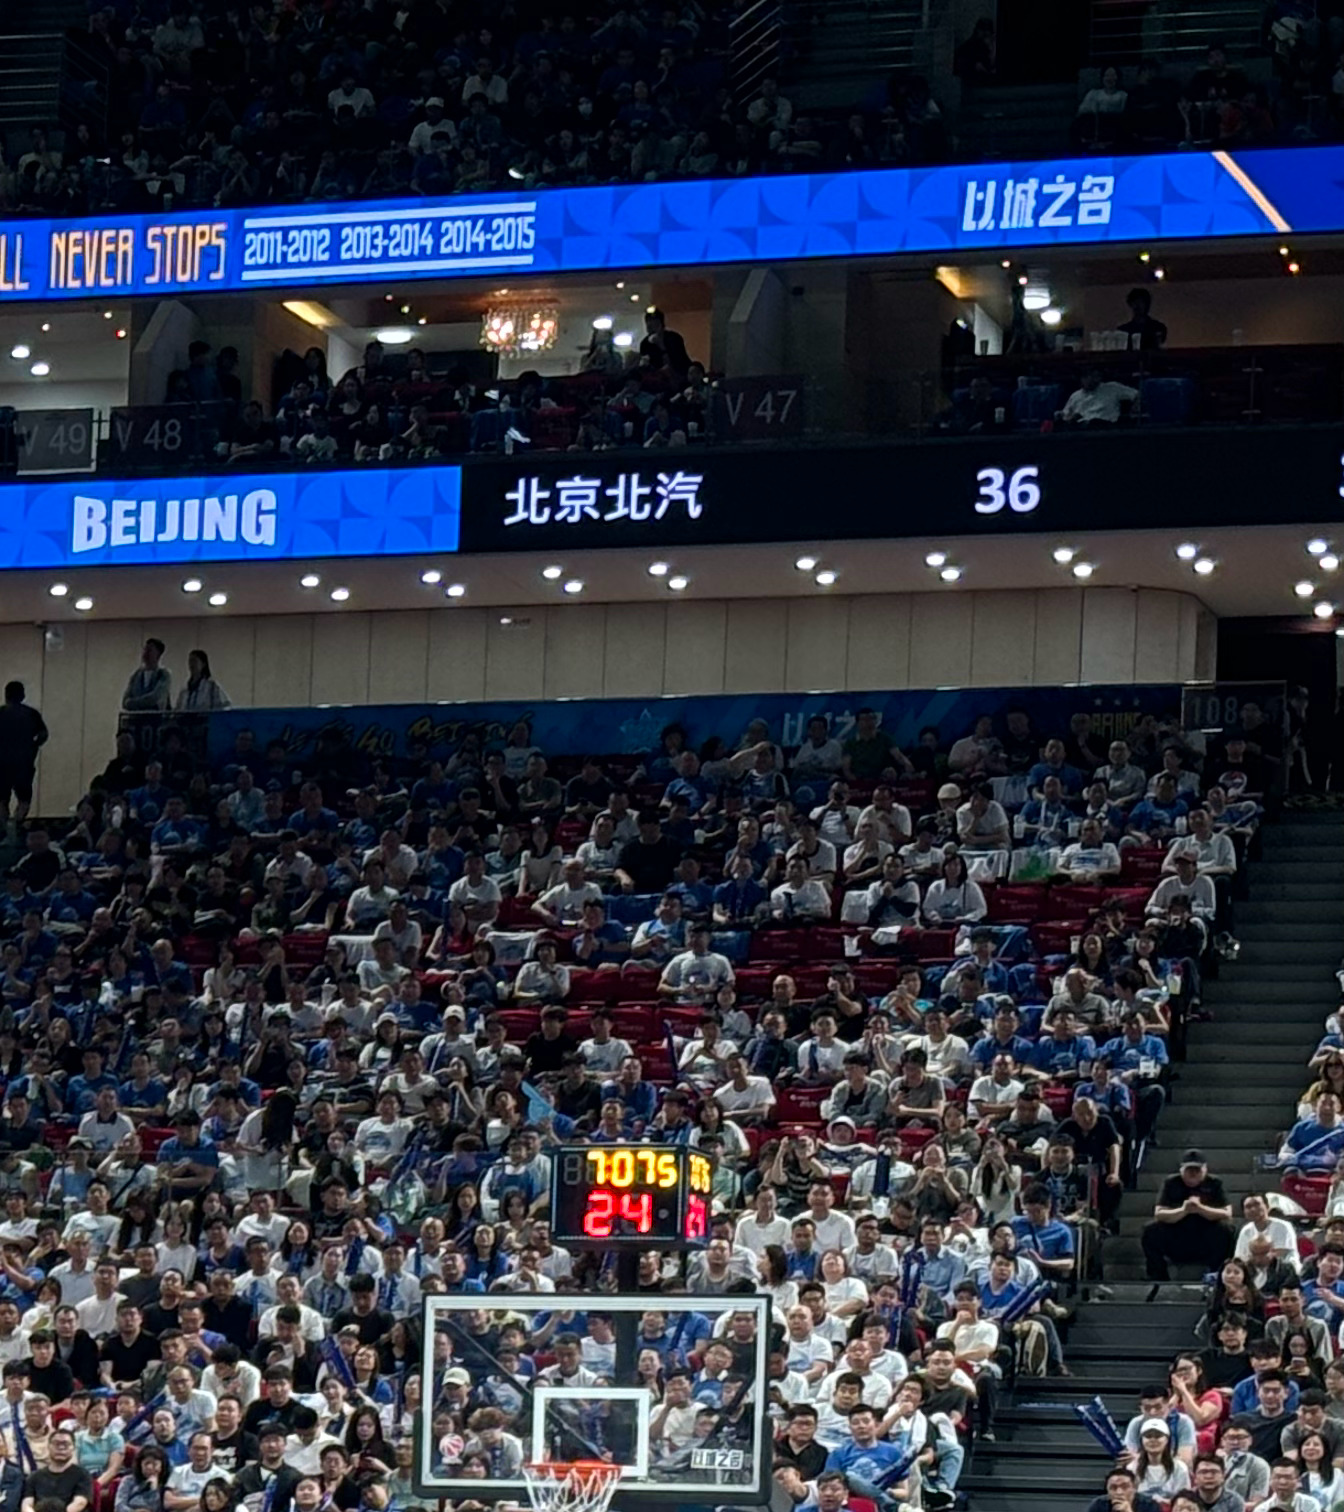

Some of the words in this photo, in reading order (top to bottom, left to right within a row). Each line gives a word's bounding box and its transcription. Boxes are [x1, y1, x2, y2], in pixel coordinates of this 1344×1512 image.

[963, 175, 1114, 232] 以城之名
[51, 229, 132, 288] NEVER
[146, 223, 225, 282] STOPS
[244, 231, 329, 265] 2011-2012
[341, 222, 433, 260] 2013-2014
[440, 216, 535, 253] 2014-2015
[755, 390, 796, 425] 47
[48, 423, 87, 455] 49
[142, 418, 182, 452] 48
[504, 472, 703, 526] 北京北汽
[975, 466, 1040, 515] 36
[73, 488, 276, 553] BEIJING
[583, 1191, 653, 1236] 24
